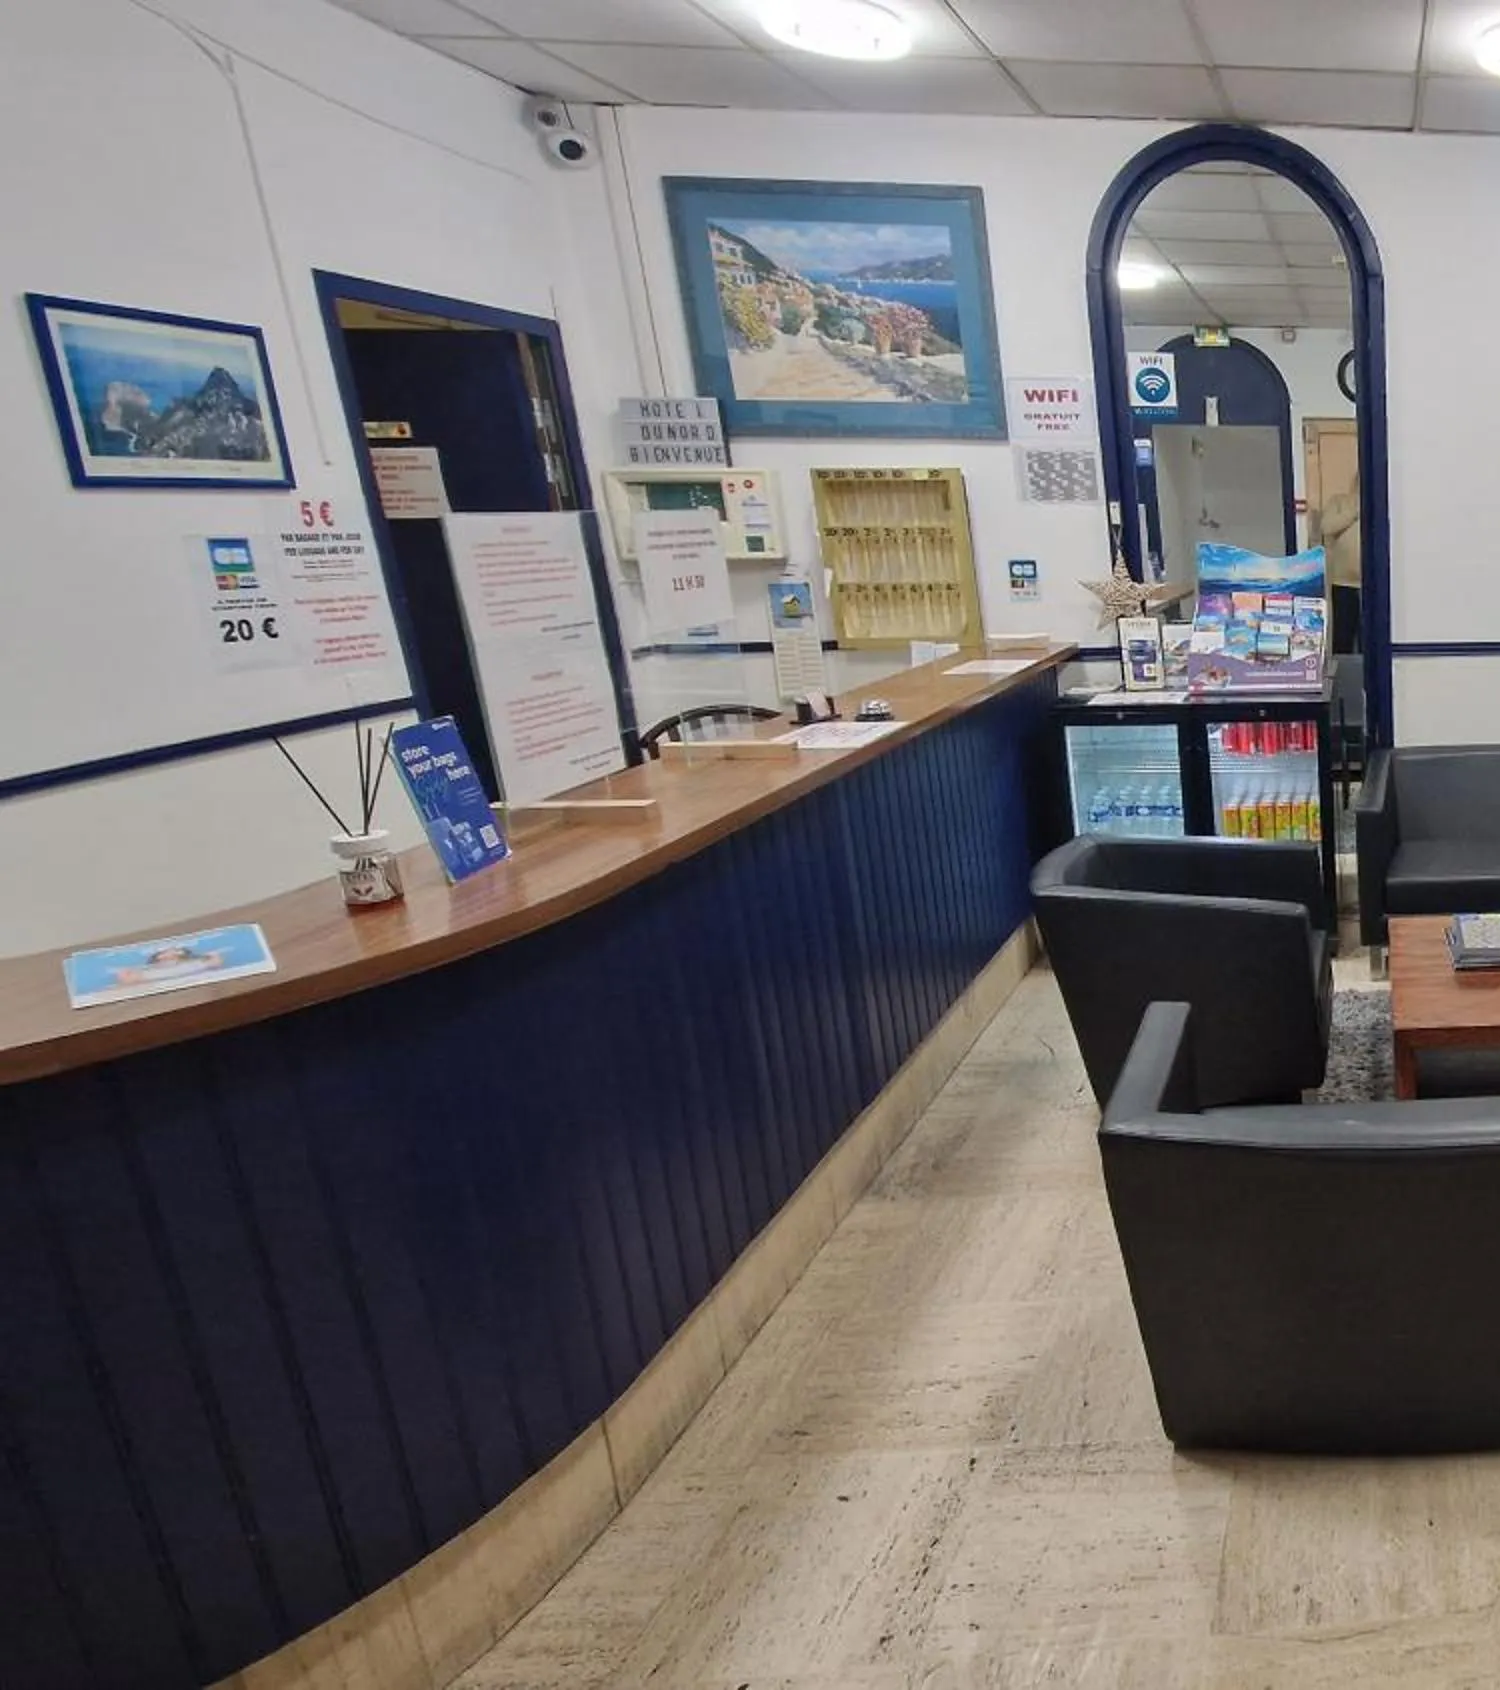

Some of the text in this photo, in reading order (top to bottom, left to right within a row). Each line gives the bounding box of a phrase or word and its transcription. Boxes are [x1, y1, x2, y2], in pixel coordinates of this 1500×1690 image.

[1139, 355, 1164, 366] WIFI
[1023, 389, 1079, 403] WIFI
[300, 500, 334, 528] 5 €
[220, 617, 279, 643] 20 €
[401, 745, 430, 763] store
[408, 751, 458, 779] your bags
[446, 765, 472, 781] here
